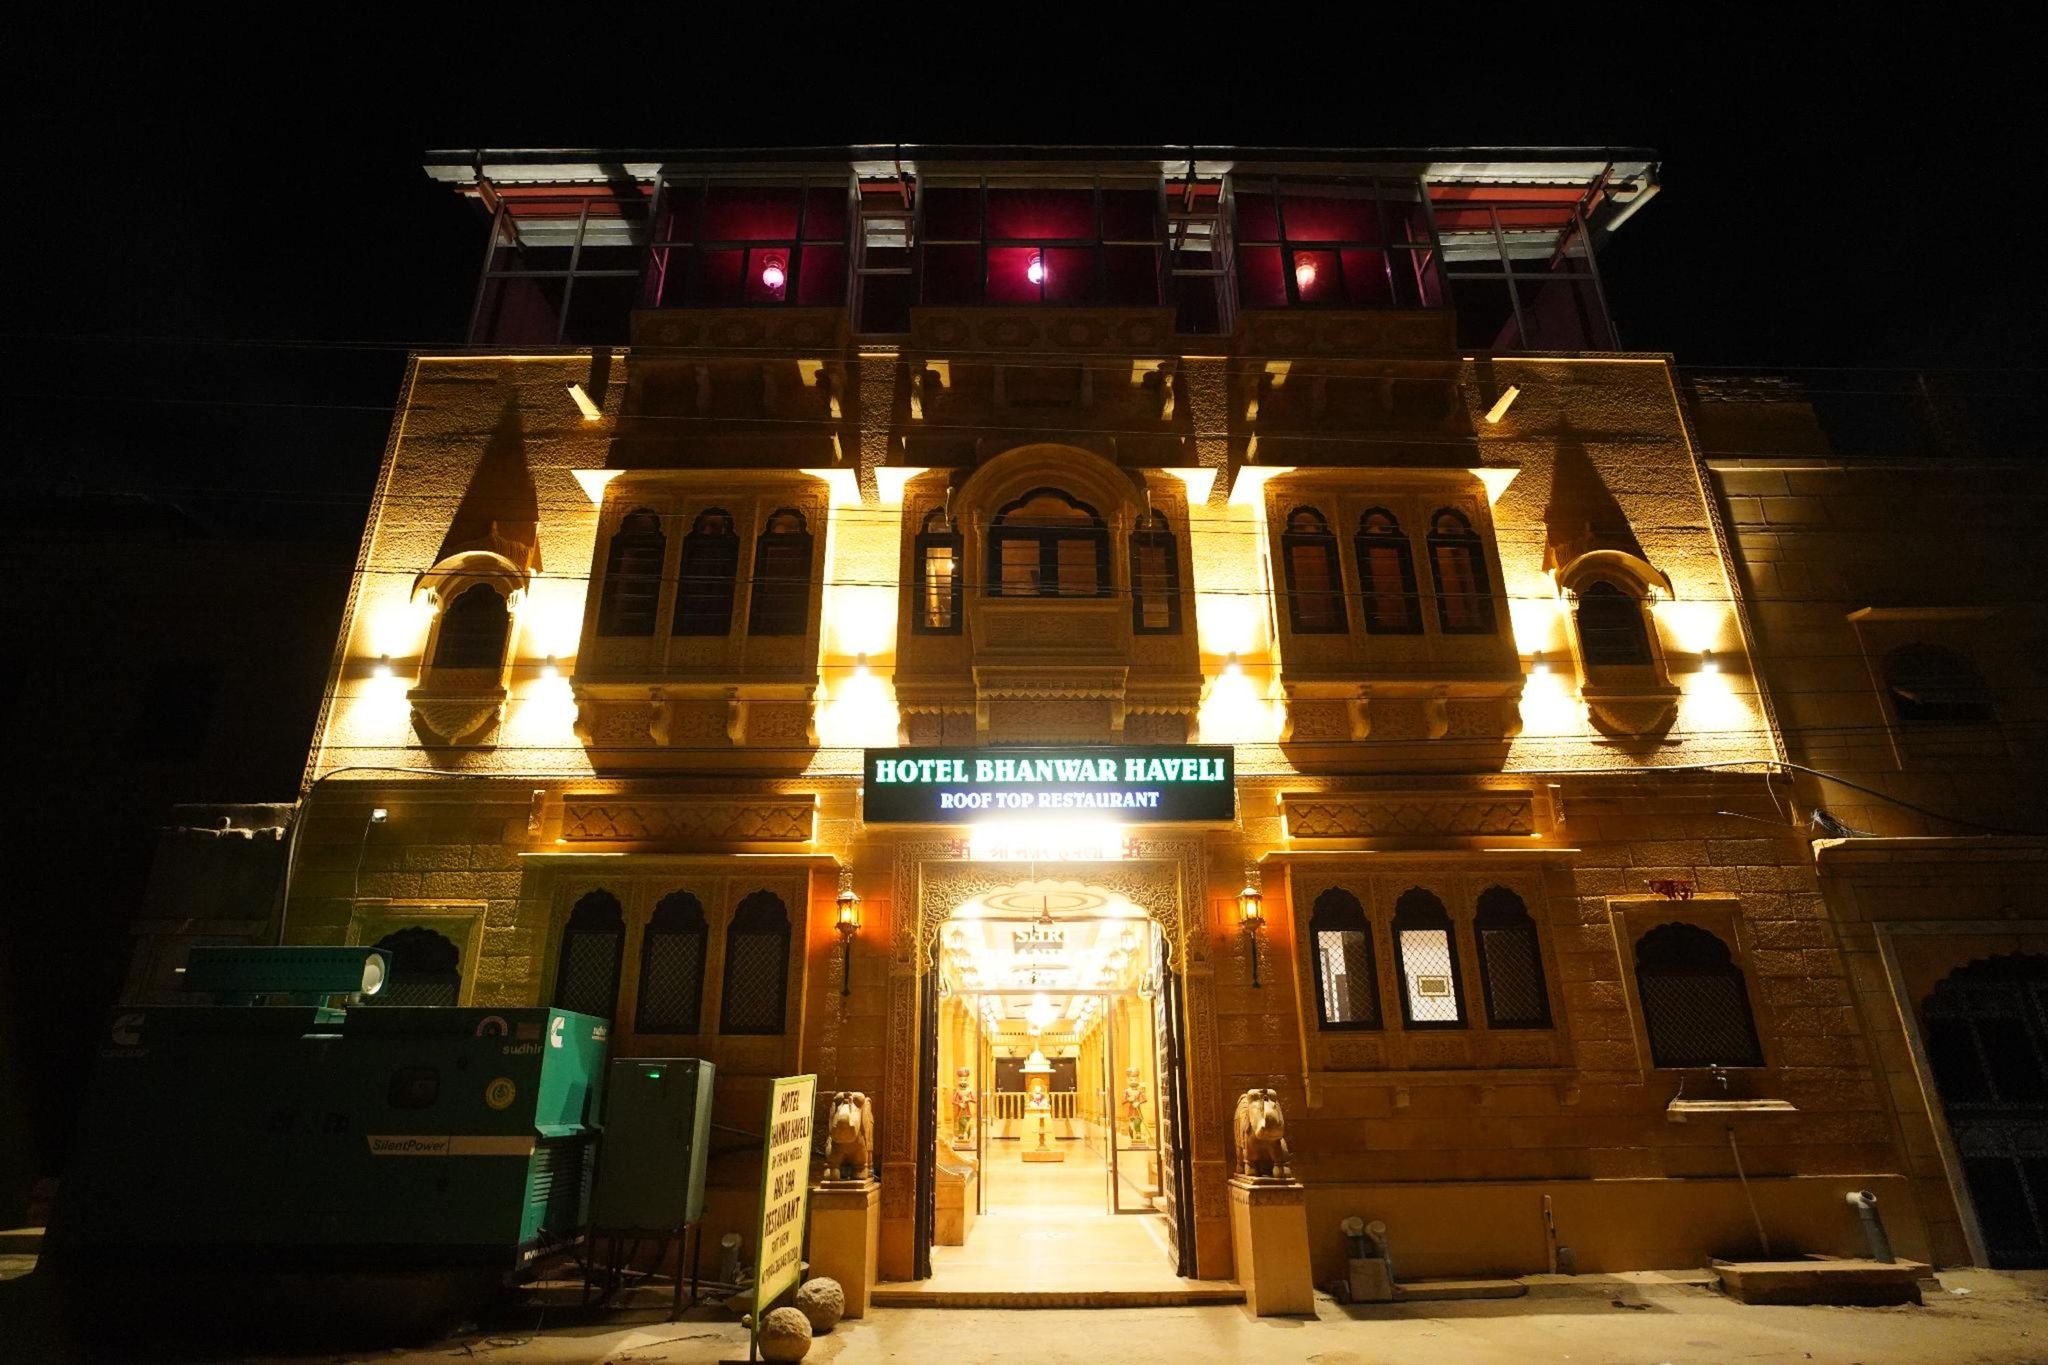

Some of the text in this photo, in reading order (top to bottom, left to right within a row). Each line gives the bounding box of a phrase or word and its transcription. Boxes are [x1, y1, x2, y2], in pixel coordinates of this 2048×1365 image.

[875, 757, 1225, 783] HOTEL BHANWAR HAVELI
[940, 791, 1160, 809] ROOF TOP RESTAURANT
[502, 1042, 542, 1056] sudhir
[779, 1089, 800, 1115] HOTEL
[372, 1138, 446, 1153] SilentPower
[764, 1195, 801, 1238] RESTAURANT
